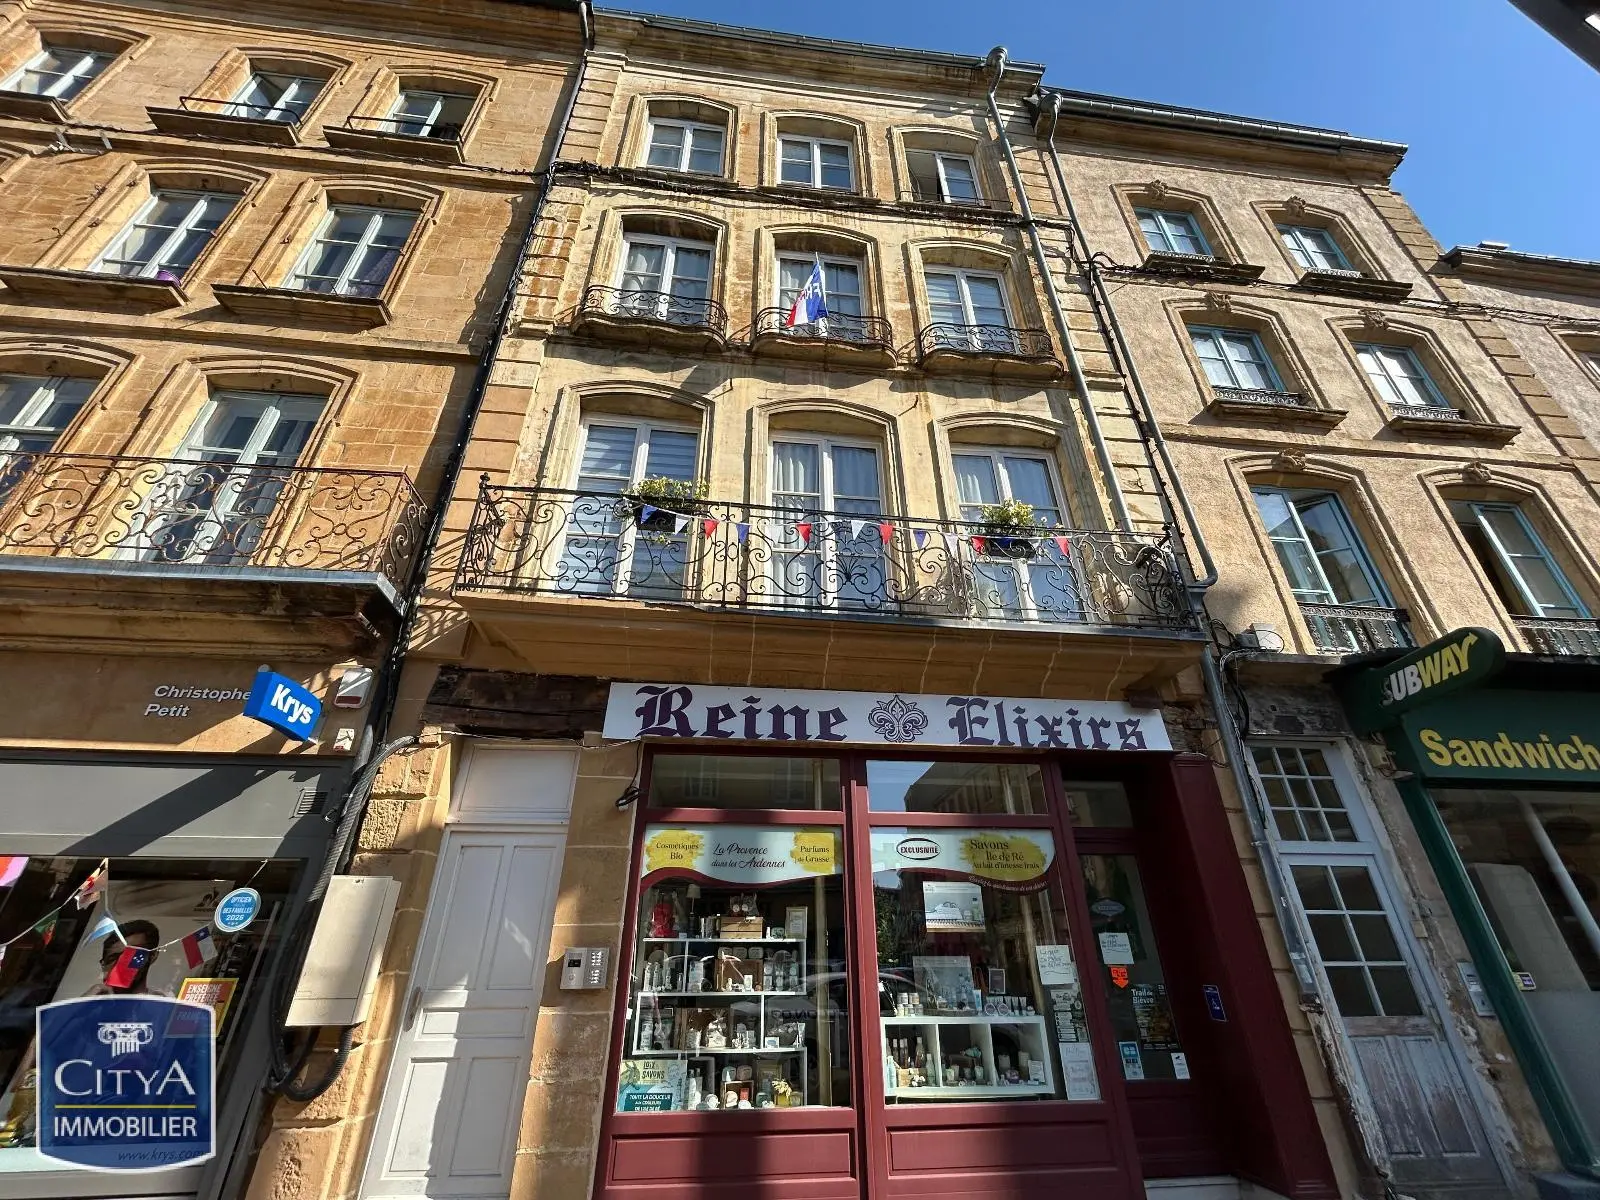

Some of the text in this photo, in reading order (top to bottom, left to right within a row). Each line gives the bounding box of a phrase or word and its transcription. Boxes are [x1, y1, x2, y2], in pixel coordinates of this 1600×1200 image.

[1380, 632, 1479, 706] SUBWAY
[154, 685, 251, 702] Christophe
[270, 683, 314, 724] Krys
[144, 703, 190, 717] Petit
[635, 685, 1148, 750] Reine Elixirs
[713, 842, 768, 855] La Provence
[800, 845, 830, 853] Parfums
[970, 839, 1009, 850] Savons
[670, 852, 683, 860] Bio
[998, 851, 1010, 862] de
[1012, 852, 1024, 862] Ré
[711, 857, 786, 869] dans les Ardennes
[982, 861, 993, 869] lait
[1023, 862, 1040, 870] frais
[1131, 988, 1147, 996] Trail
[641, 1070, 665, 1080] SAVONS
